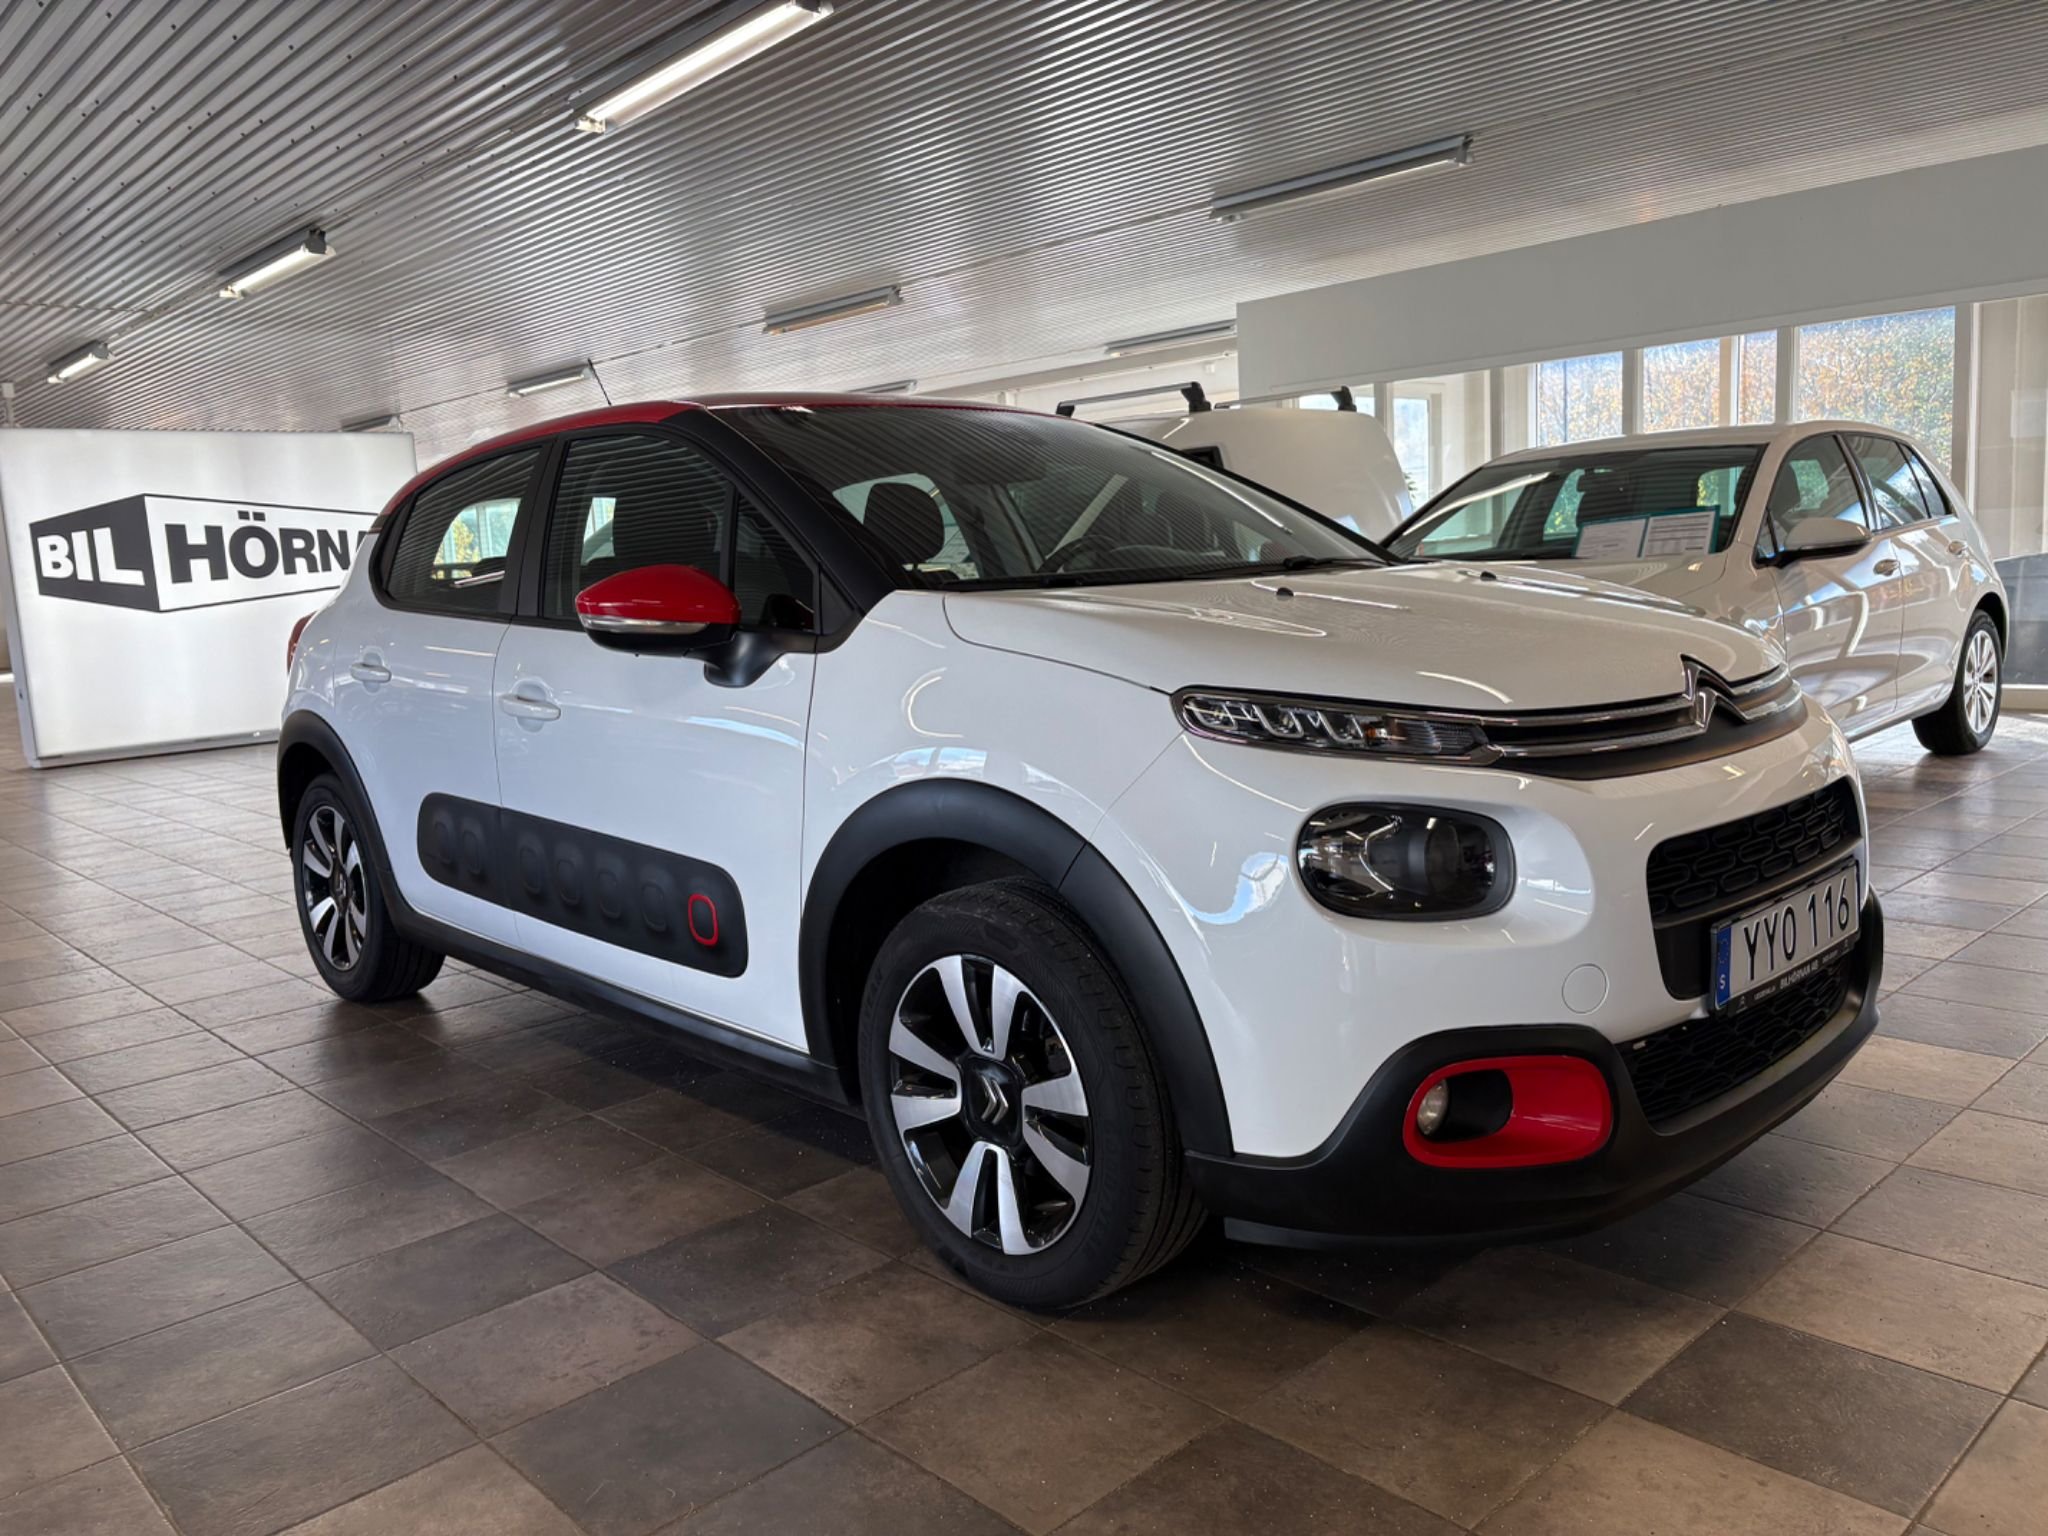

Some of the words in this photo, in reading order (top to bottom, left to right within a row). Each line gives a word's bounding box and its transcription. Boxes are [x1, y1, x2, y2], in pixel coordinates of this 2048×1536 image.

[37, 527, 145, 586] BIL
[1744, 906, 1796, 980] YYO
[1807, 877, 1849, 947] 116
[1719, 974, 1726, 989] S
